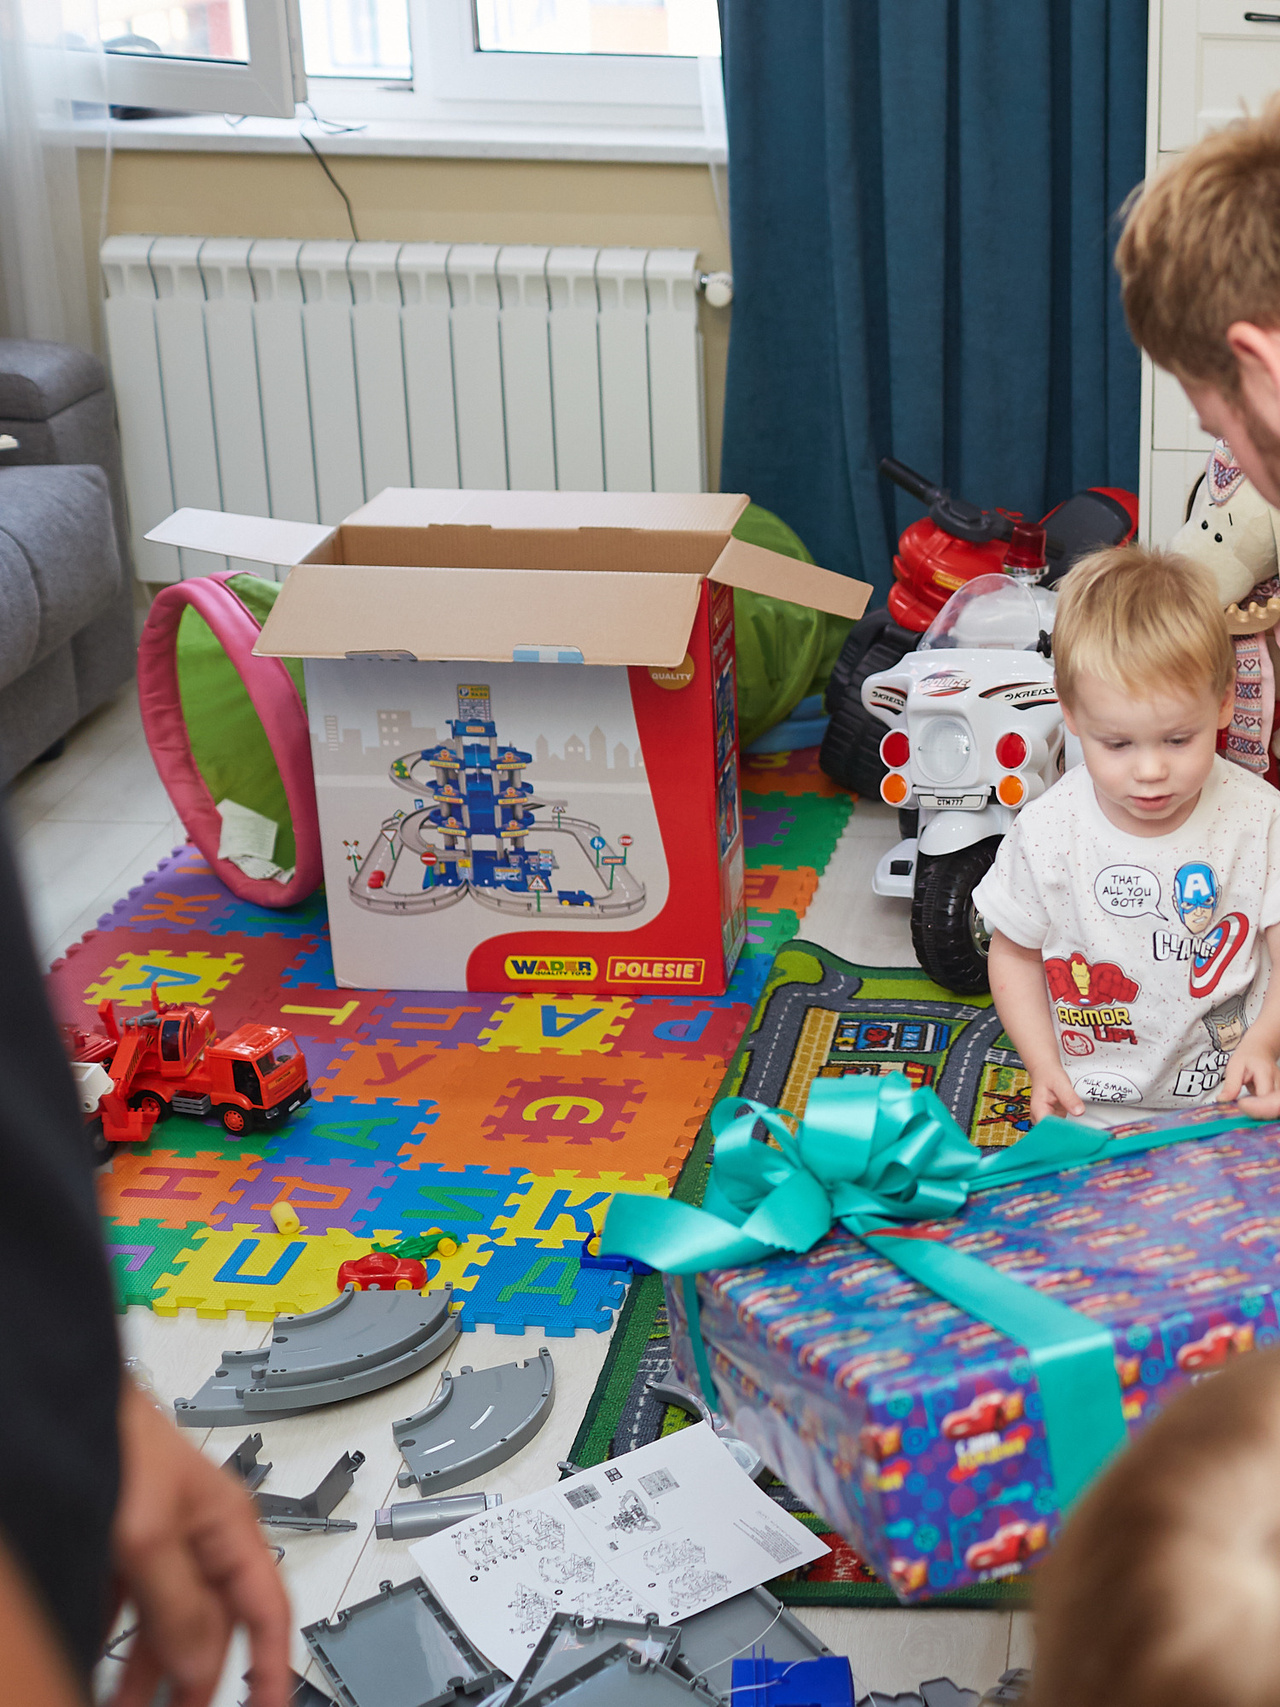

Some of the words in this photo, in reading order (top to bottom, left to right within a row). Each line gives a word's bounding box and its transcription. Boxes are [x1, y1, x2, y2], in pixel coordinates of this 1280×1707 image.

[651, 673, 691, 681] QUALITY
[920, 677, 971, 689] POLICE
[1111, 874, 1141, 885] THAT
[1183, 872, 1211, 899] A
[1102, 886, 1123, 895] ALL
[1127, 887, 1151, 897] YOU
[129, 891, 222, 925] Ж
[1110, 898, 1144, 908] GOT?
[1153, 928, 1217, 961] CLANG!
[511, 959, 592, 975] WADER
[614, 962, 695, 979] POLESIE
[280, 1000, 361, 1026] Т
[540, 1005, 605, 1038] А
[1057, 1006, 1132, 1026] ARMOR
[1092, 1024, 1138, 1045] UP!
[363, 1052, 437, 1086] У
[1103, 1082, 1133, 1094] SMASH
[1173, 1069, 1226, 1097] BO
[1086, 1087, 1108, 1098] ALL
[1110, 1092, 1127, 1101] OF
[310, 1117, 399, 1150] А
[533, 1189, 612, 1234] К
[496, 1256, 582, 1306] Д
